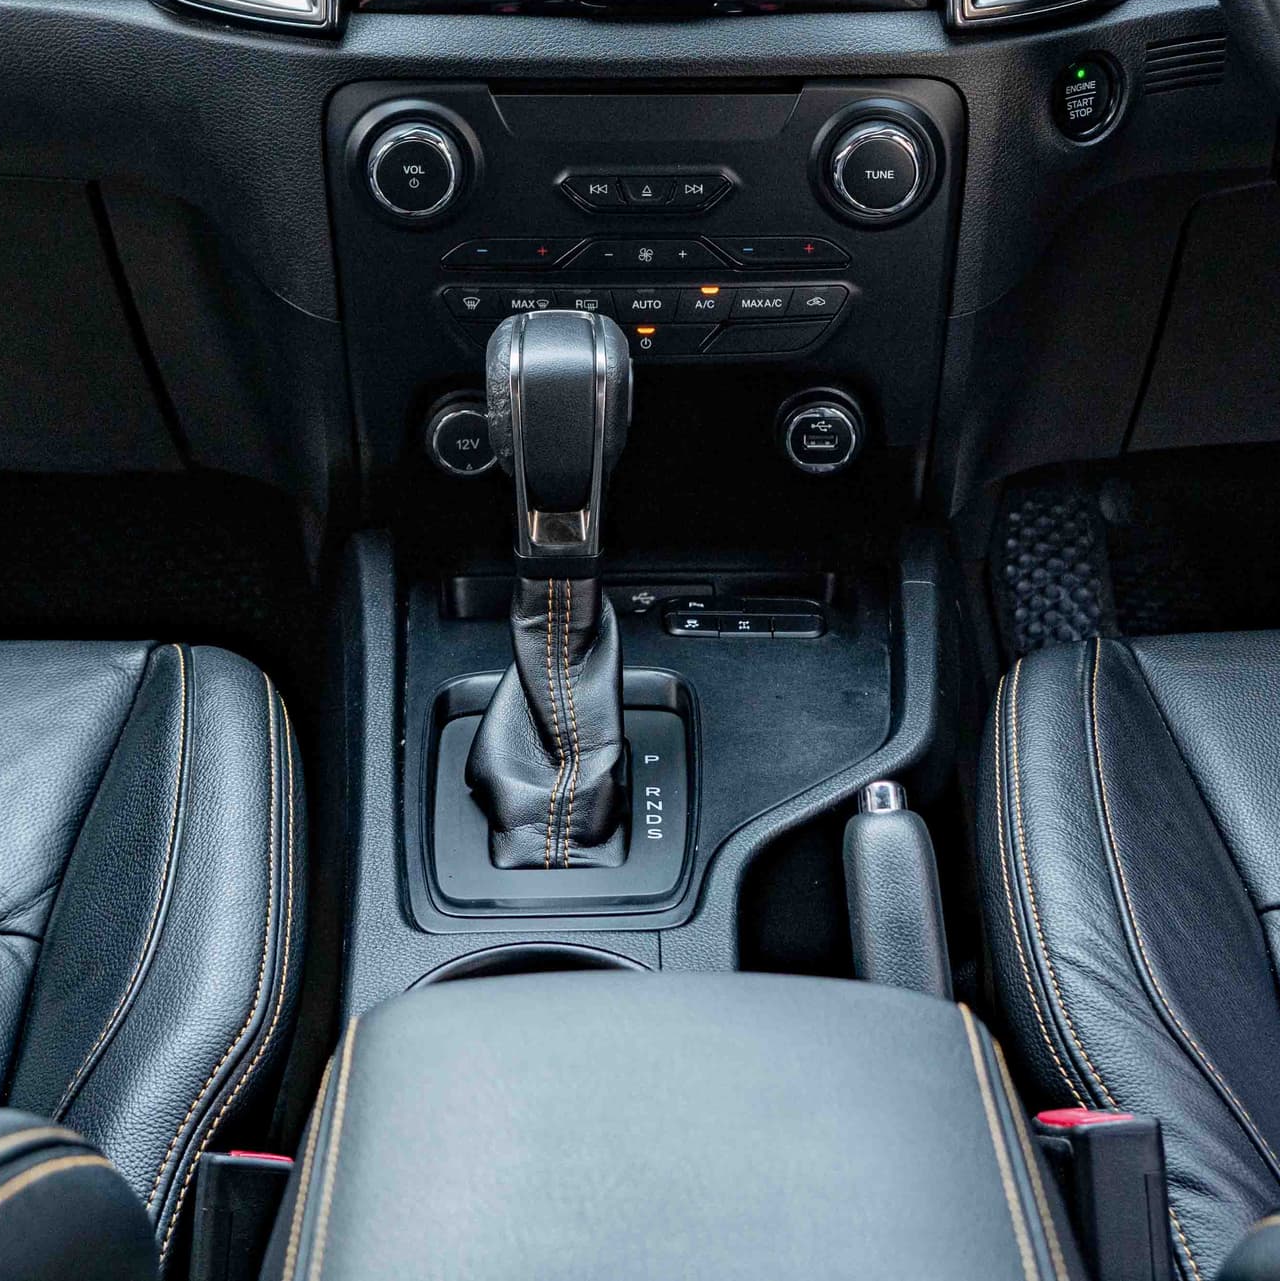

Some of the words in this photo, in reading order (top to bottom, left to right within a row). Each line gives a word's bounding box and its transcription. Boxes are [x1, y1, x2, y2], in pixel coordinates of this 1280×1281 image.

[1065, 80, 1096, 95] ENGINE
[1066, 96, 1095, 111] START
[1069, 107, 1093, 120] STOP
[403, 165, 425, 175] VOL
[865, 170, 895, 179] TUNE
[511, 299, 535, 309] MAX
[575, 299, 584, 309] R
[631, 299, 662, 309] AUTO
[695, 299, 715, 310] A/C
[455, 438, 480, 451] 12V
[644, 754, 660, 764] P
[645, 786, 661, 797] R
[646, 800, 663, 811] N
[646, 814, 662, 825] D
[647, 828, 663, 839] S
